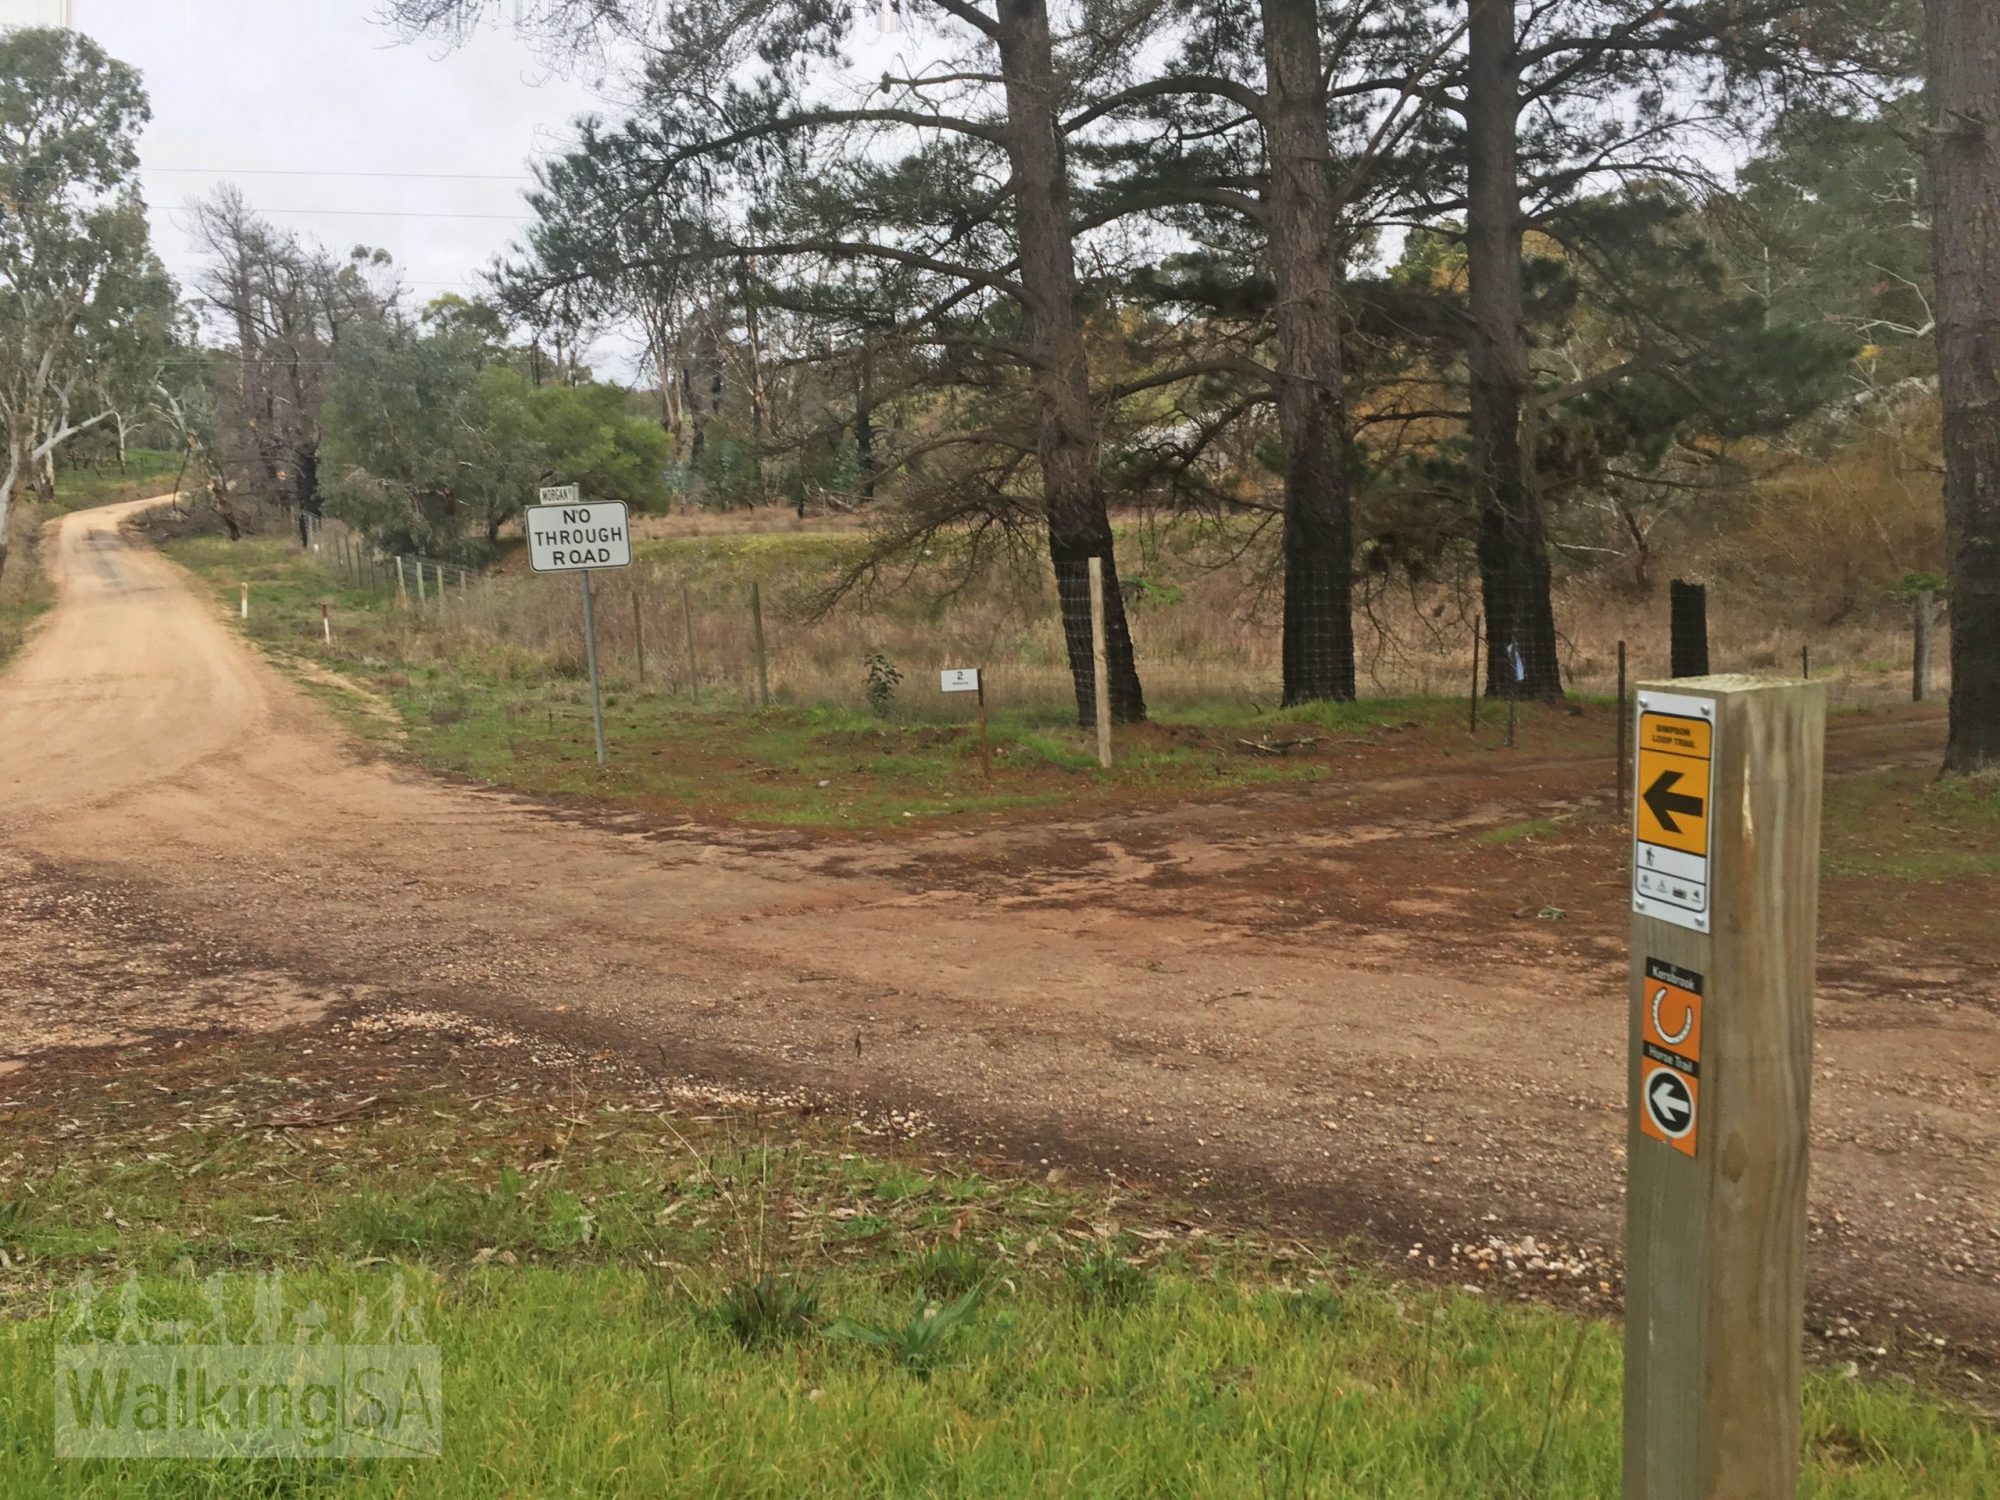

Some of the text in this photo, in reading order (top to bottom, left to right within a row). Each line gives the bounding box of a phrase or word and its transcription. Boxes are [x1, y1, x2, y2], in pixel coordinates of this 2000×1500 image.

[542, 488, 568, 502] MORGAN
[563, 508, 591, 525] NO
[534, 527, 622, 546] THROUGH
[552, 548, 611, 566] ROAD
[956, 671, 964, 680] 2
[1656, 724, 1691, 736] SIMPSON
[1652, 734, 1696, 749] LOOP TRAIL
[1652, 965, 1696, 991] Kersbrook
[1648, 1044, 1693, 1074] Horse Trail
